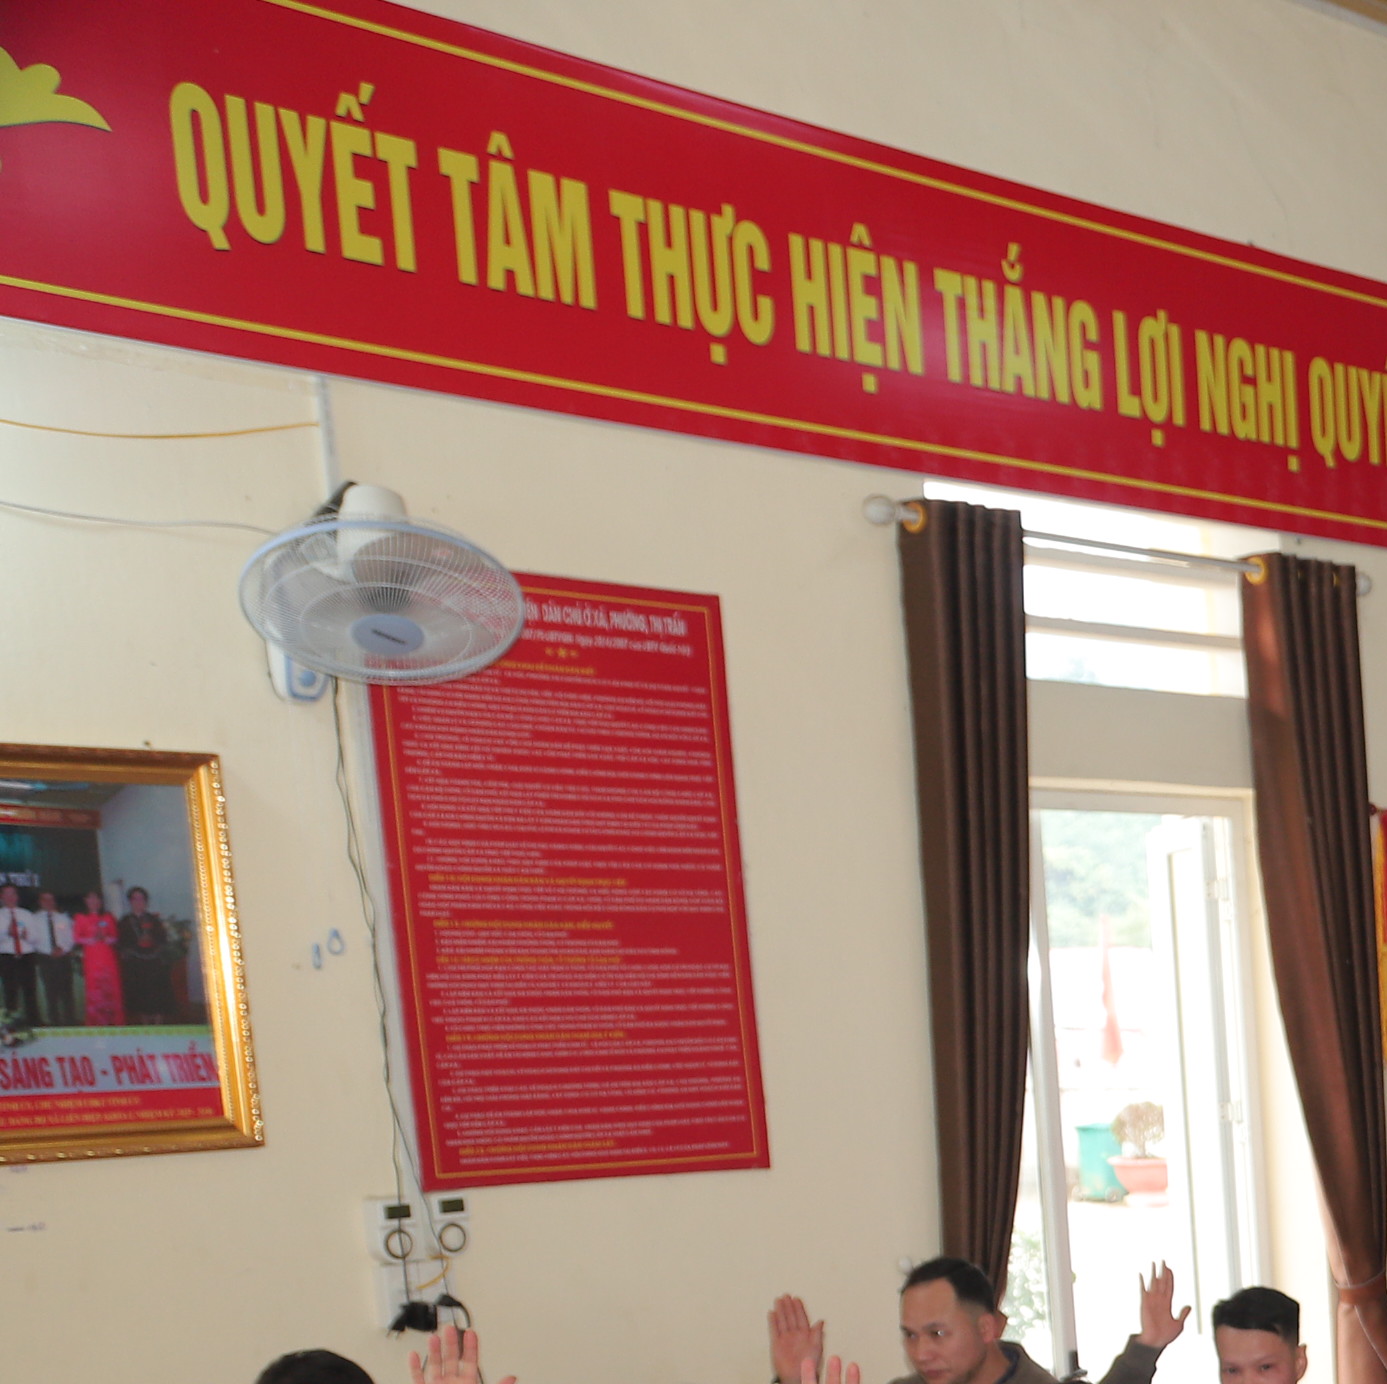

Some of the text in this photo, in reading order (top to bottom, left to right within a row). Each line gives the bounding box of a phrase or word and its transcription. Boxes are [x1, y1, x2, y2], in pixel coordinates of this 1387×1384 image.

[169, 81, 417, 273] QUYẾT
[438, 130, 597, 310] TÂM
[608, 189, 774, 366] THỰC
[789, 223, 924, 394] HIỆN
[933, 242, 1103, 412] THẮNG
[1111, 309, 1186, 447] LỢI
[1195, 329, 1300, 473] NGHỊ
[0, 1051, 54, 1089] SÁNG
[56, 1055, 96, 1093] TẠO
[109, 1047, 161, 1085] PHÁT
